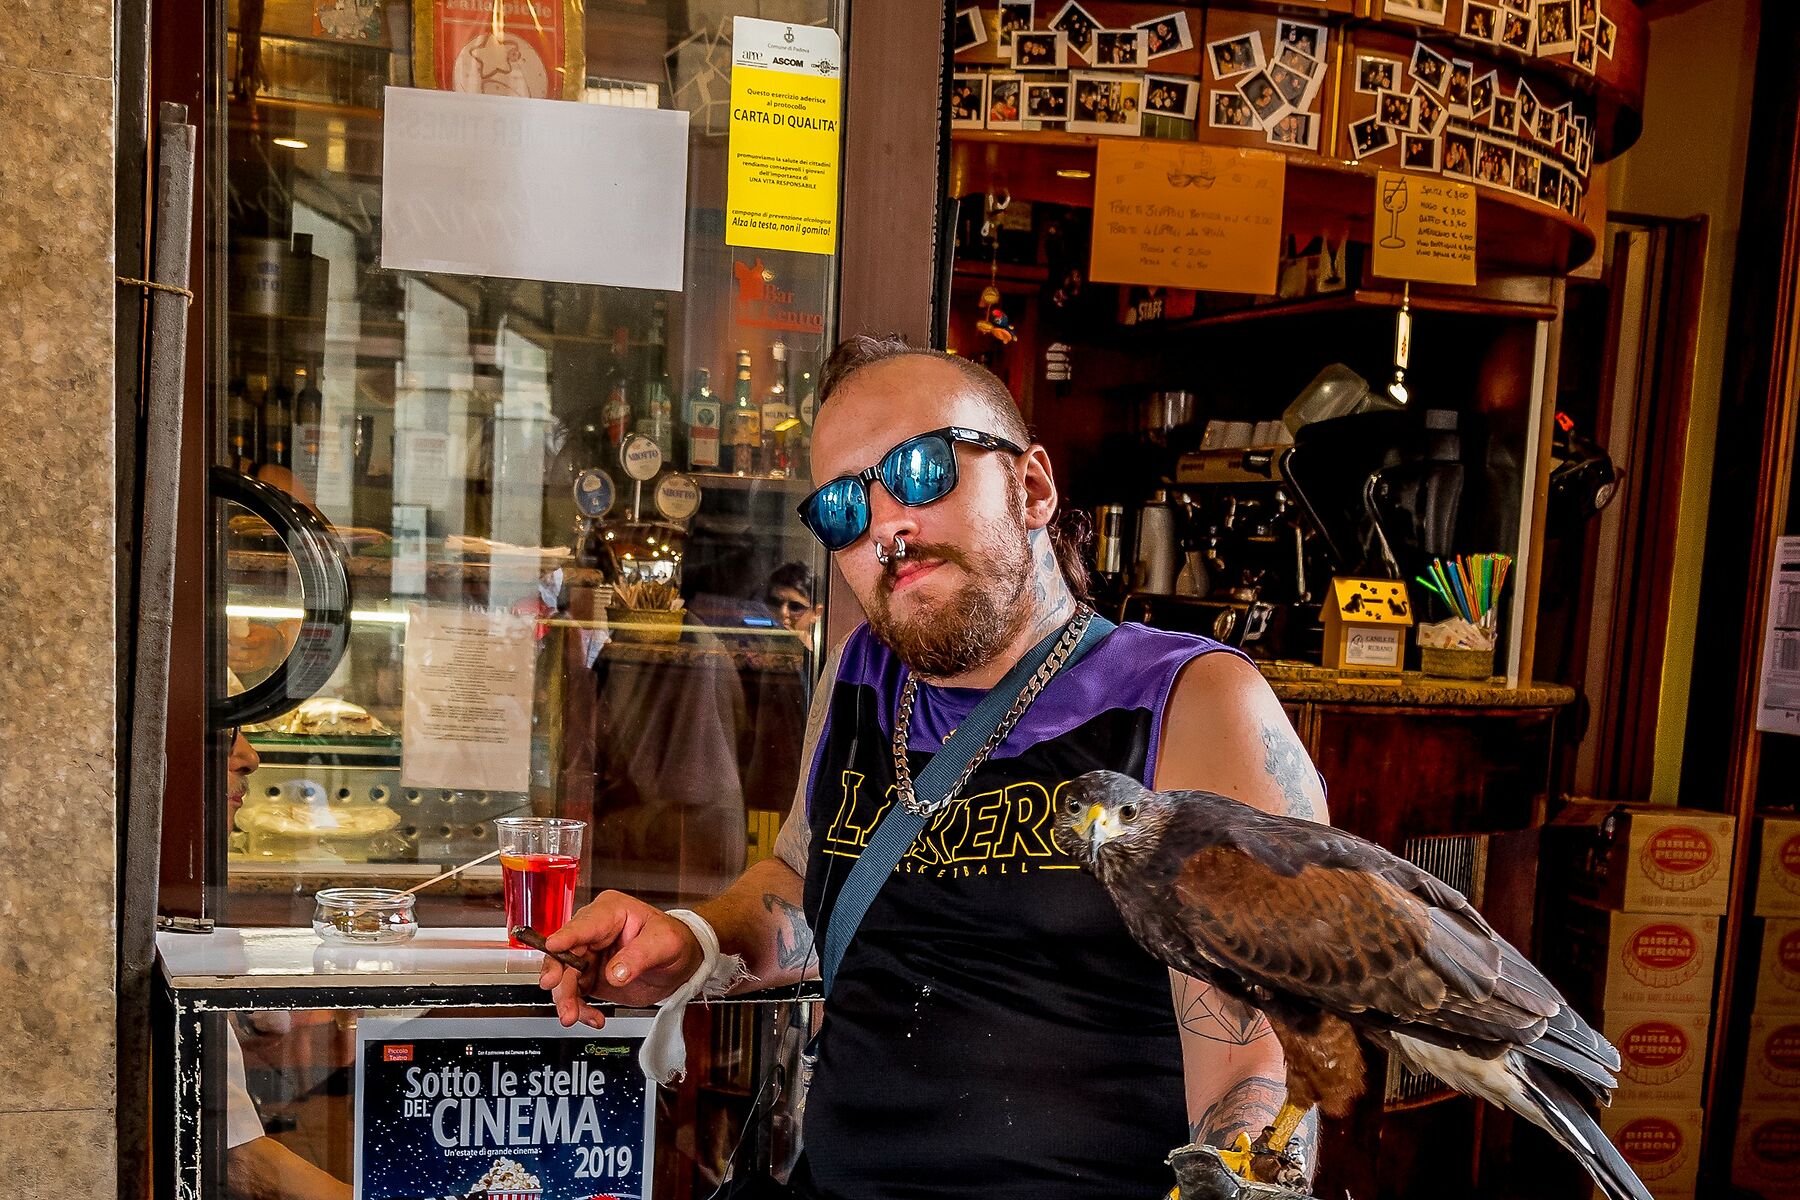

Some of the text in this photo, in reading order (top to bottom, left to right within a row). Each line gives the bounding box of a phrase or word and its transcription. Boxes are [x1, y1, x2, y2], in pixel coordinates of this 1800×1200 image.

[772, 56, 804, 68] ASCOM
[747, 88, 826, 104] Questo esercizio aderisce
[773, 101, 807, 110] protocollo
[734, 108, 838, 132] CARTA DI QUALITA'
[736, 152, 776, 162] promuoviamo
[808, 160, 831, 168] cittadini
[770, 164, 802, 172] consapevoli
[806, 167, 826, 175] giovani
[776, 179, 817, 190] RESPONSABILE
[732, 217, 831, 236] Alza la testa, non il gomito!
[827, 770, 1070, 865] LKER
[1656, 840, 1707, 850] BIRRA
[1655, 850, 1708, 861] PERONI
[893, 862, 1029, 878] ASKETBALL
[1638, 936, 1691, 946] BIRRA
[1638, 946, 1691, 957] PERONI
[1630, 1034, 1681, 1044] BIRRA
[1629, 1045, 1682, 1054] PERONI
[405, 1060, 606, 1098] Sotto le stelle
[404, 1096, 604, 1148] DEL CINEMA
[1626, 1130, 1676, 1140] BIRRA
[1624, 1141, 1676, 1150] PERONI
[444, 1148, 478, 1157] Un'estate
[479, 1148, 486, 1156] di
[486, 1148, 512, 1158] grande
[574, 1146, 632, 1178] 2019
